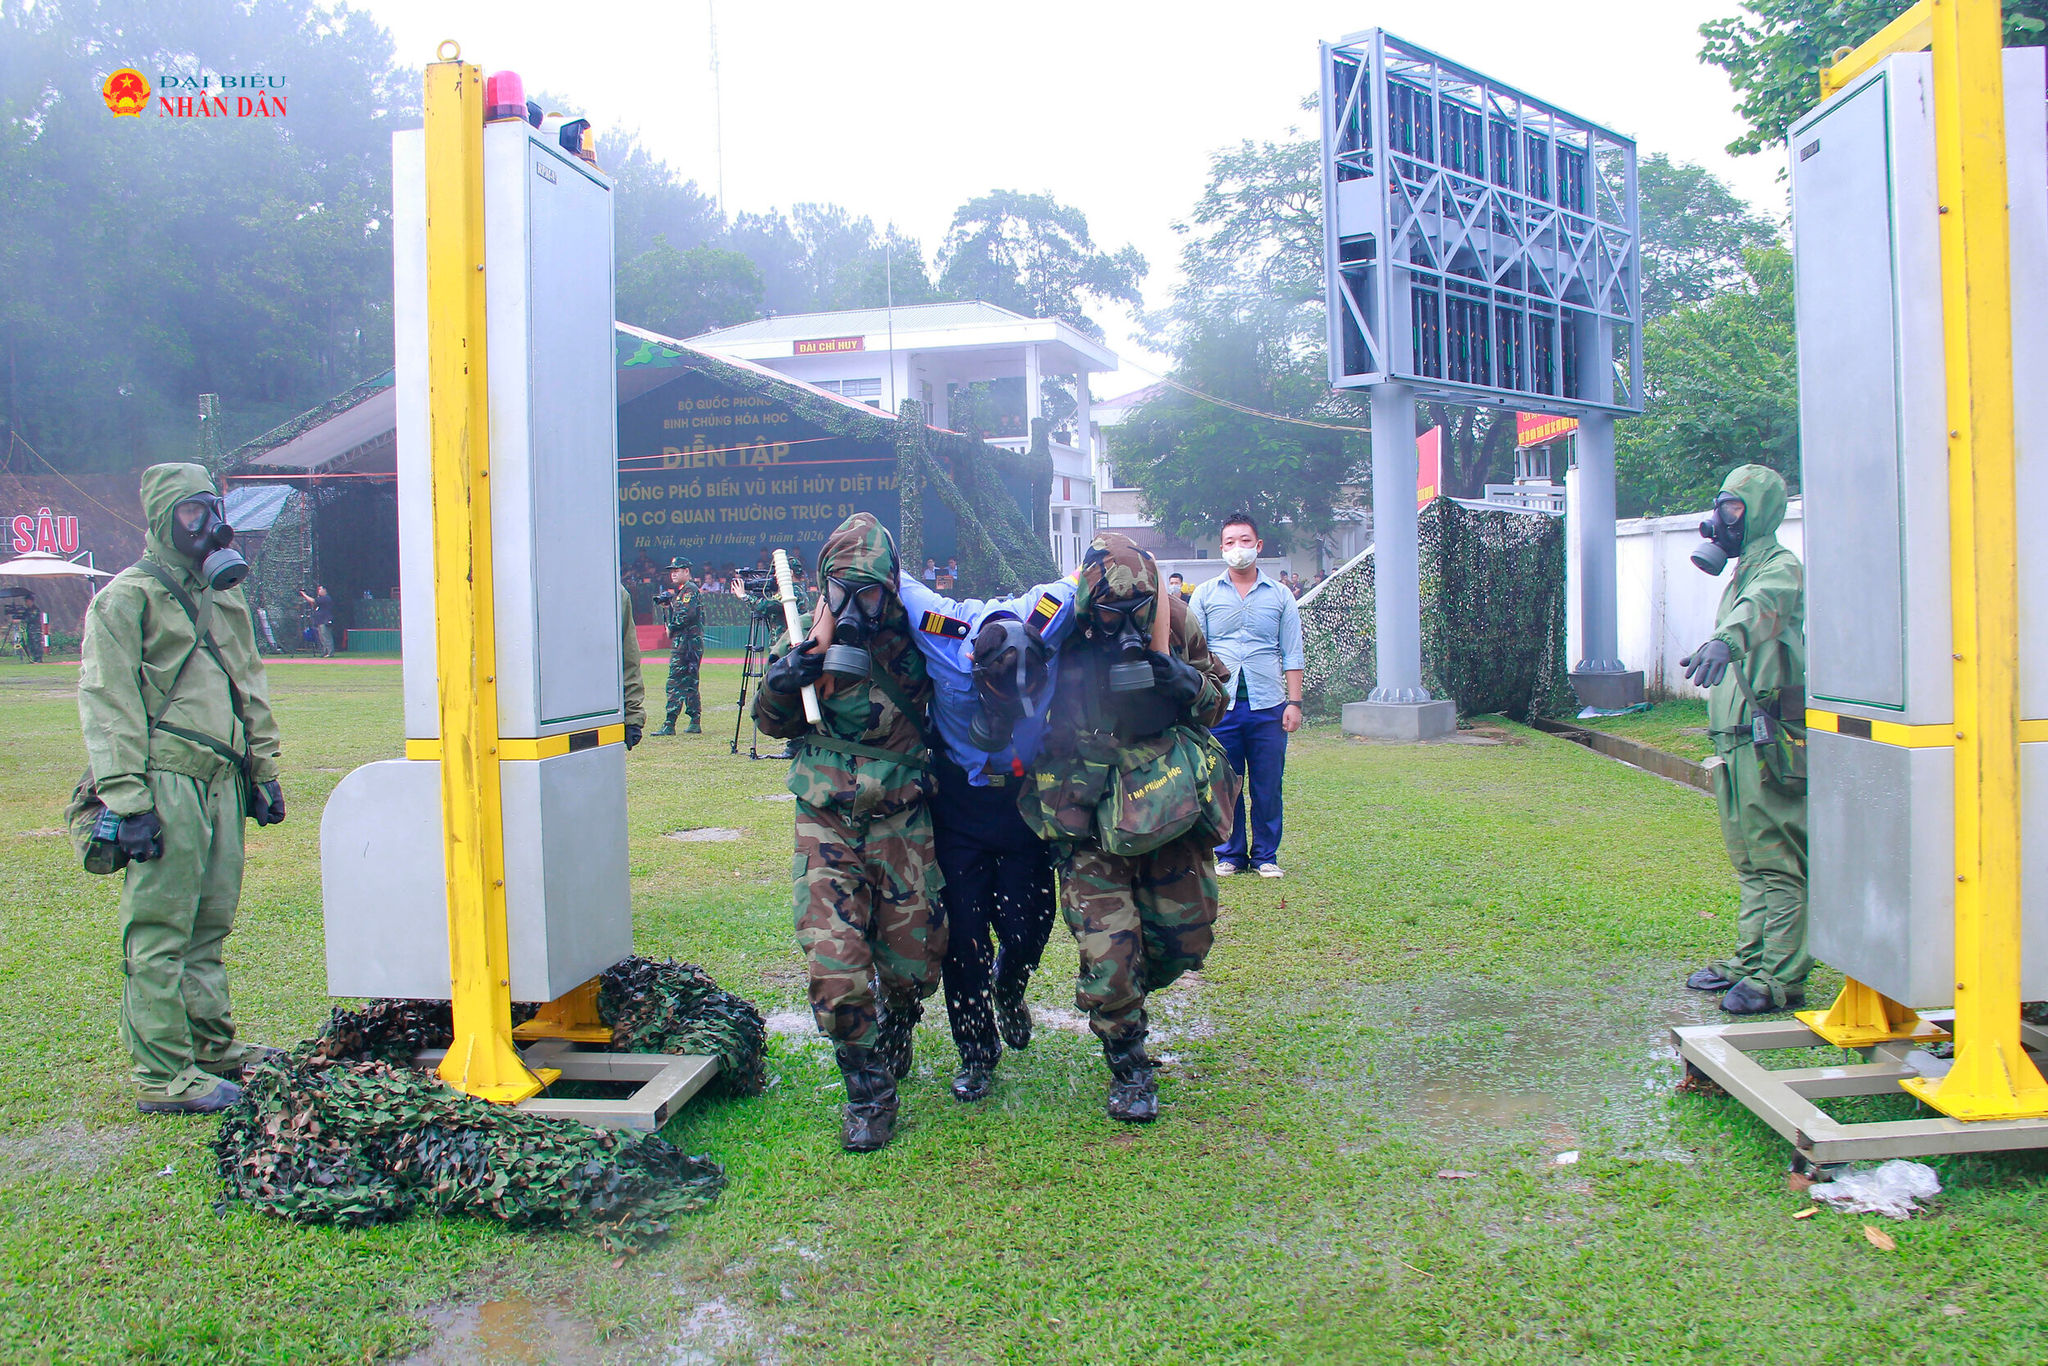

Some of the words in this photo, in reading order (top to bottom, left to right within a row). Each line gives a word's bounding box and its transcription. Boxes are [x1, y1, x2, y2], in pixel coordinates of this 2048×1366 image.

[838, 340, 858, 350] HUY
[678, 399, 694, 413] BỘ
[696, 395, 730, 410] QUỐC
[664, 418, 688, 429] BINH
[763, 413, 789, 426] HỌC
[663, 434, 727, 468] DIỄN
[736, 435, 790, 472] TẬP
[619, 480, 664, 501] UỐNG
[669, 476, 702, 499] PHỔ
[706, 476, 740, 497] BIẾN
[745, 478, 766, 496] VŨ
[772, 476, 798, 495] KHÍ
[840, 474, 874, 495] DIỆT
[642, 508, 666, 526] CƠ
[671, 508, 716, 524] QUAN
[720, 503, 786, 522] THƯỜNG
[792, 502, 833, 524] TRỰC
[838, 504, 856, 518] 81
[13, 507, 79, 553] SÂU
[634, 536, 651, 548] Hà
[680, 534, 706, 548] ngày
[710, 533, 722, 544] 10
[724, 532, 756, 545] tháng
[760, 532, 766, 542] 9
[768, 532, 794, 542] năm
[797, 530, 824, 542] 2026
